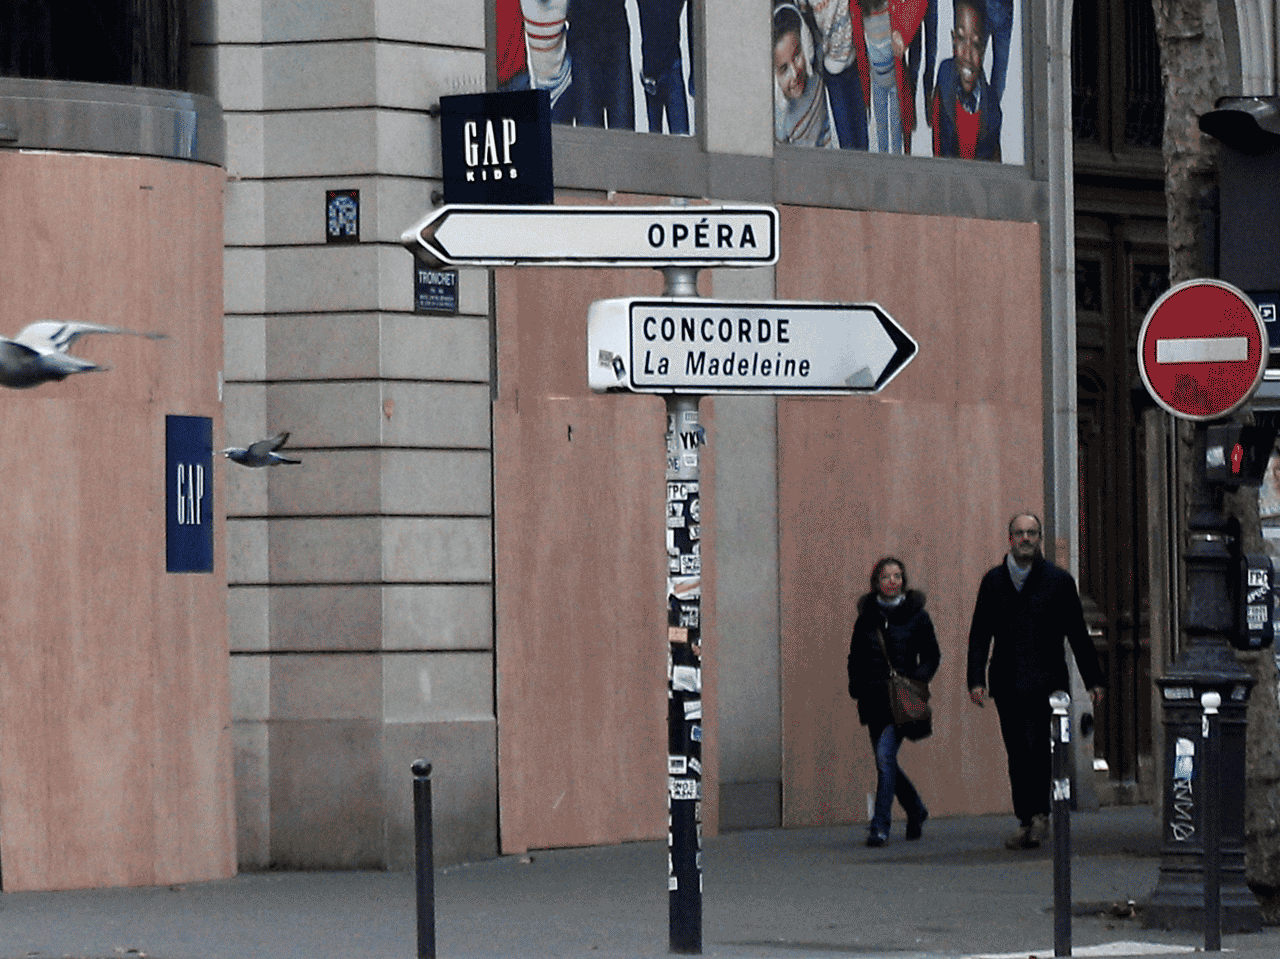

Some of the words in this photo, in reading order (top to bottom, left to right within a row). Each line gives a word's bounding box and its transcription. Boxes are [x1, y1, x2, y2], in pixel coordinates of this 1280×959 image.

[464, 119, 517, 167] GAP
[466, 168, 518, 182] KIDS
[647, 218, 757, 249] OPÉRA
[643, 316, 791, 344] CONCORDE
[644, 350, 670, 376] La
[685, 350, 811, 377] Madeleine
[177, 463, 204, 525] GAP
